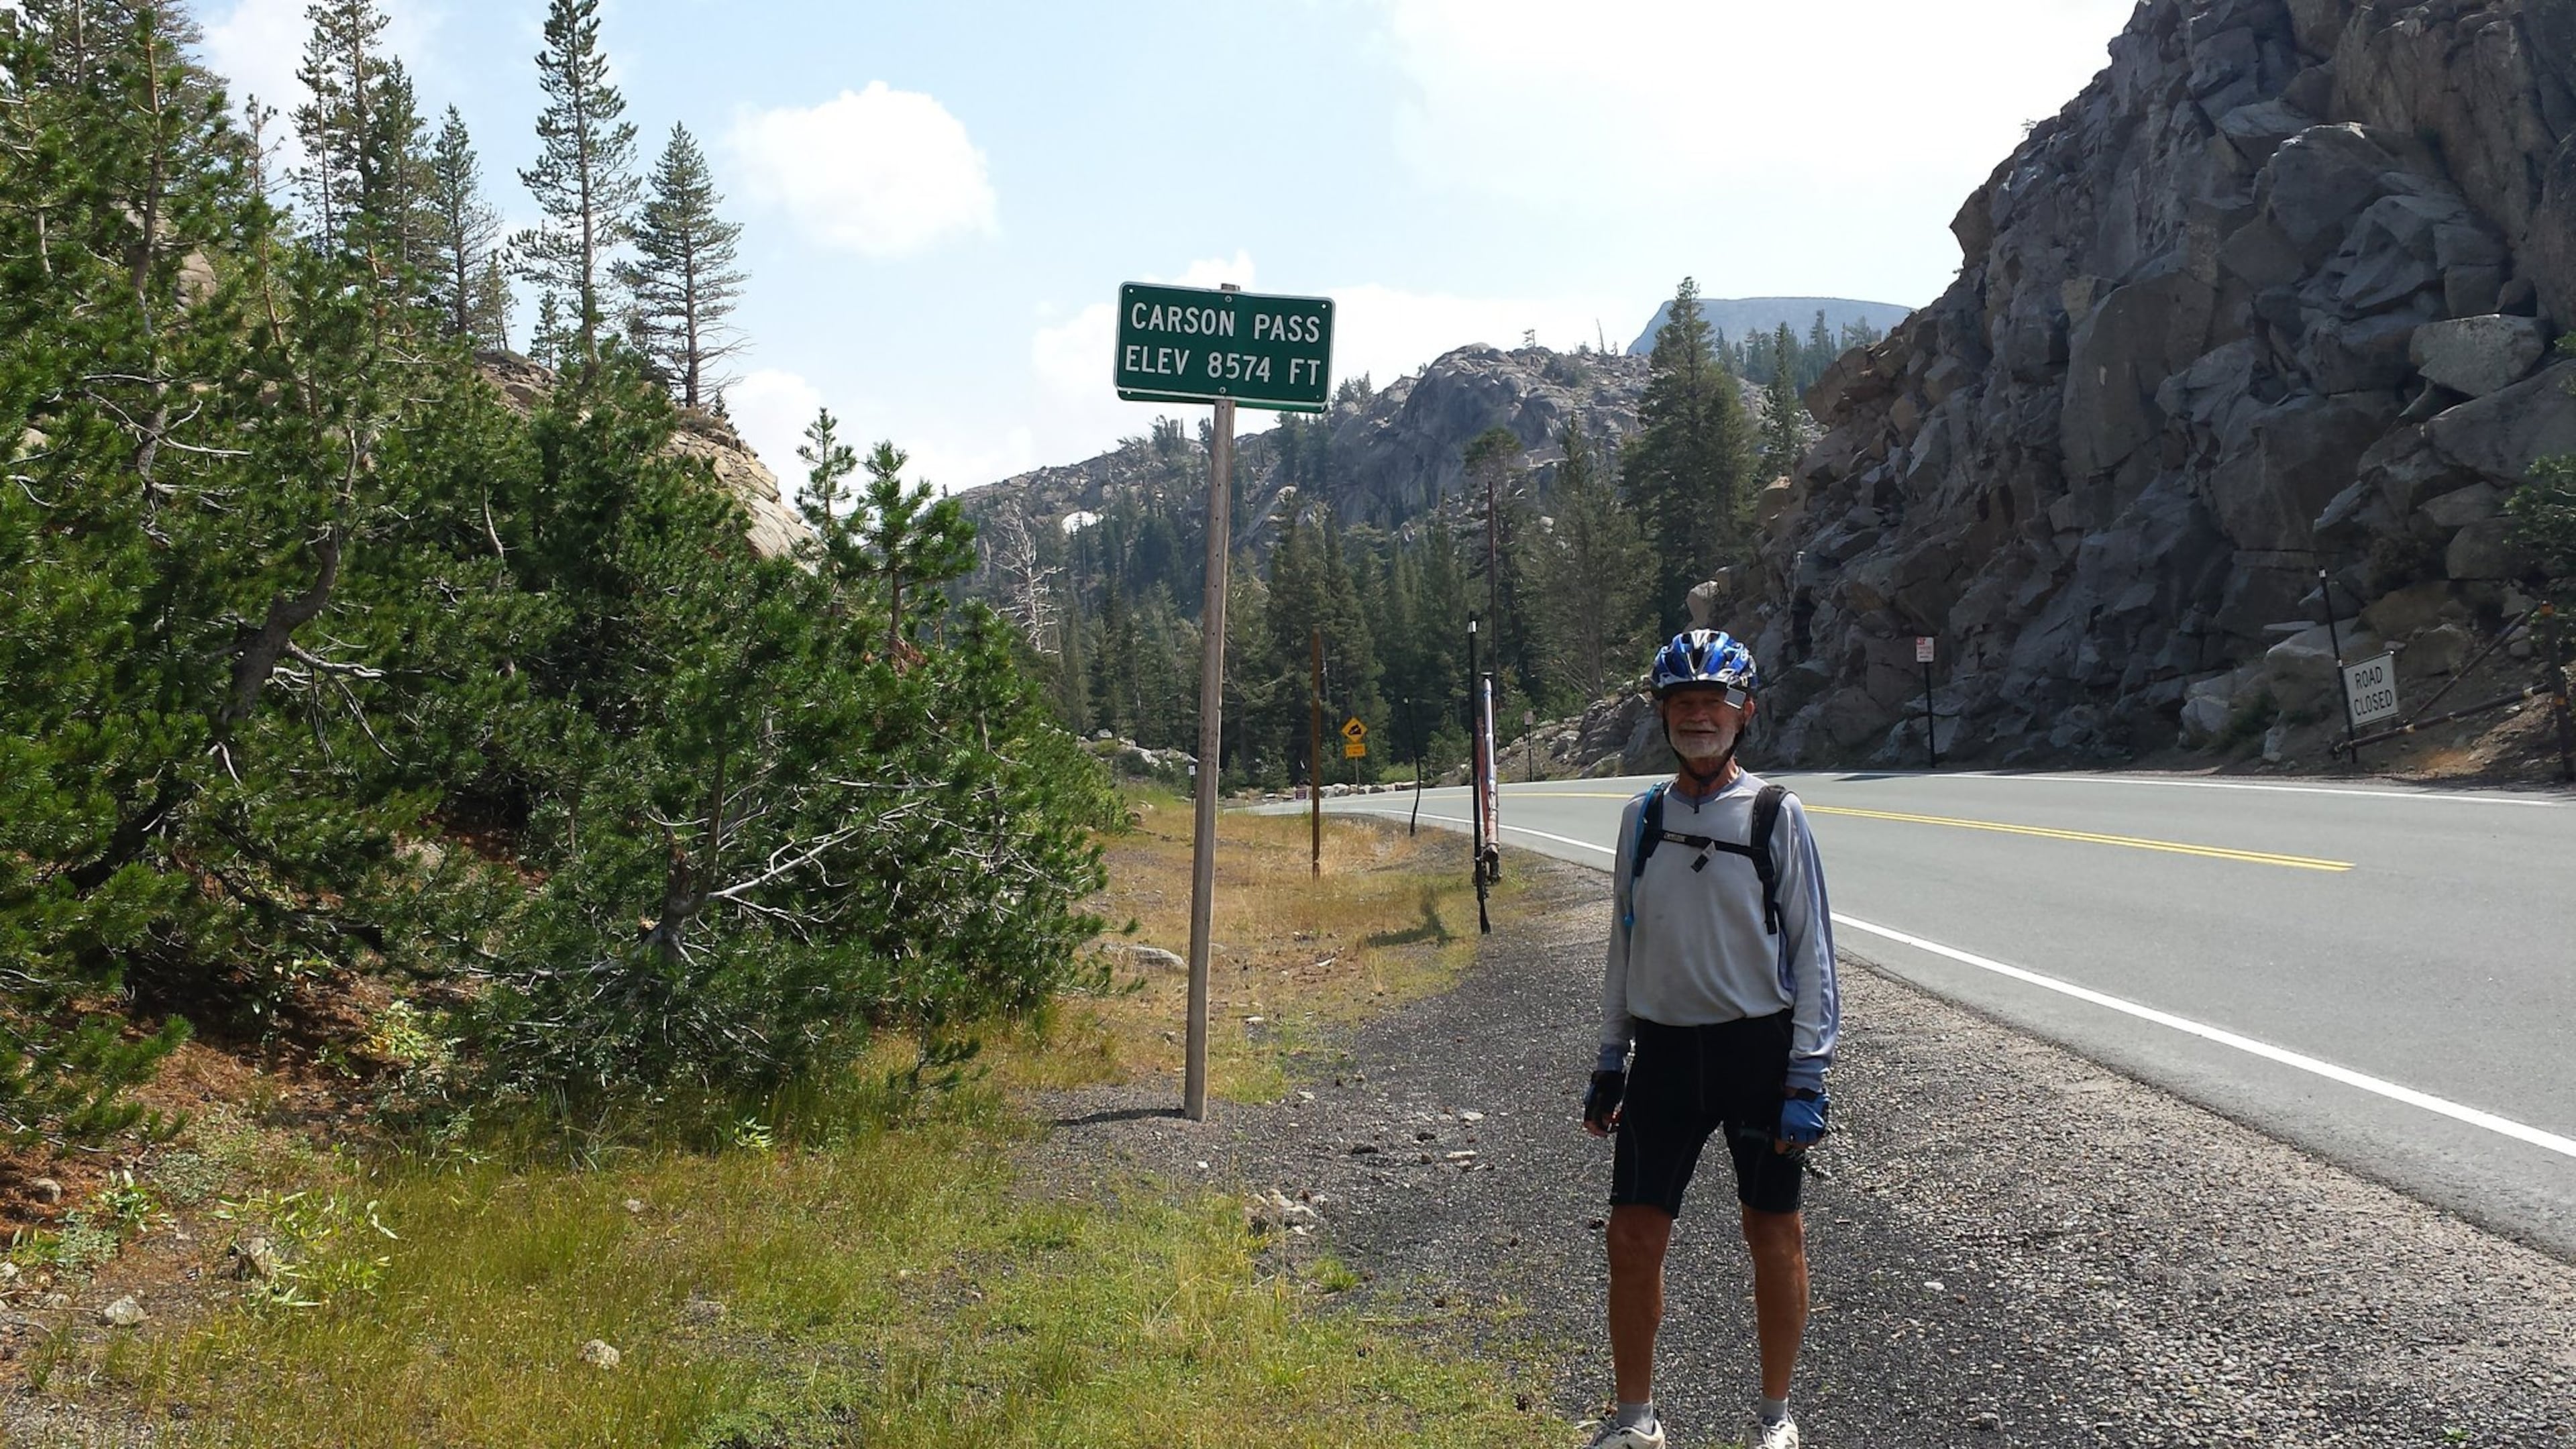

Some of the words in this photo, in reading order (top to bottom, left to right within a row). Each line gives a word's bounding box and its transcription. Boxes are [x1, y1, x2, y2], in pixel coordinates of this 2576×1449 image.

[1131, 303, 1235, 335] CARSON
[1254, 313, 1320, 343] PASS
[1125, 345, 1190, 375] ELEV
[1208, 352, 1271, 383] 8574
[1289, 358, 1321, 386] FT
[2355, 666, 2383, 689] ROAD
[2354, 689, 2393, 716] CLOSED
